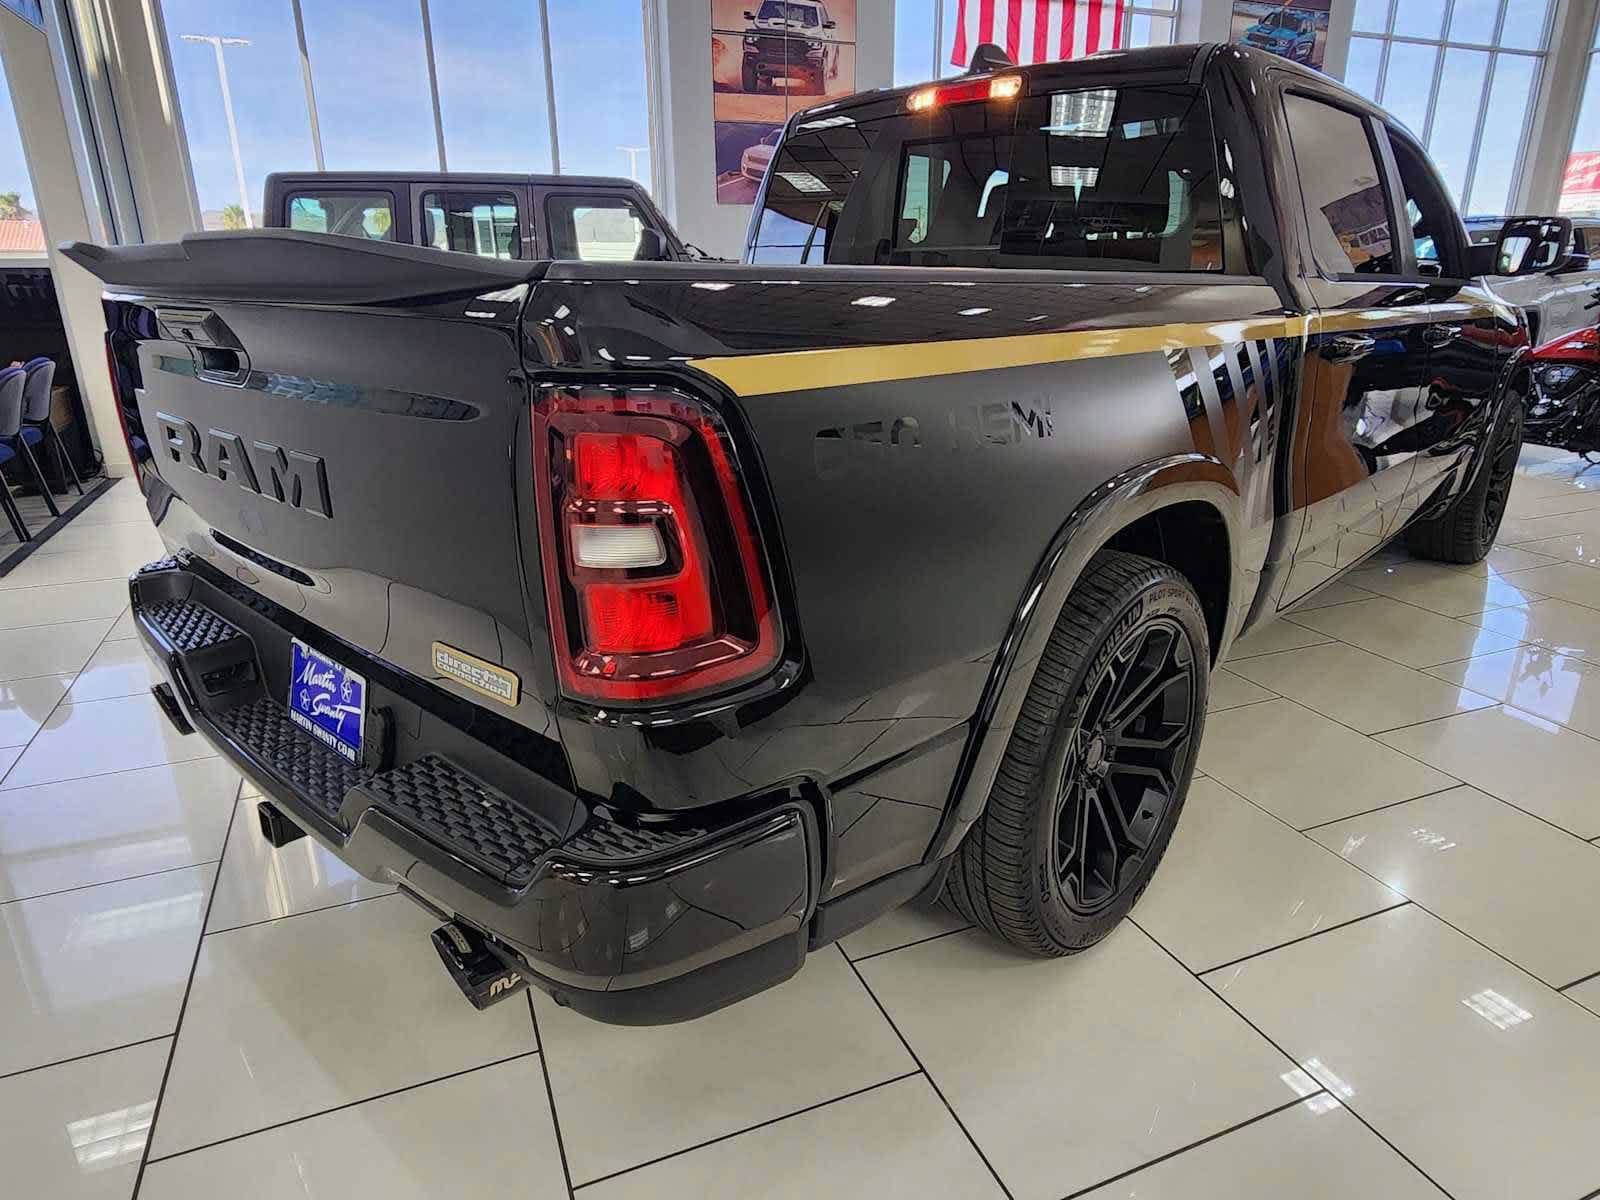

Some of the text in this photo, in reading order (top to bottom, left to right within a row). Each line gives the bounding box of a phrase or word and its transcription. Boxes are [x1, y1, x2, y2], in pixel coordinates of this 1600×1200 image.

[156, 411, 333, 519] RAM
[296, 660, 337, 693] Martin
[1084, 600, 1142, 695] MICHELIN
[310, 693, 362, 733] Swanty
